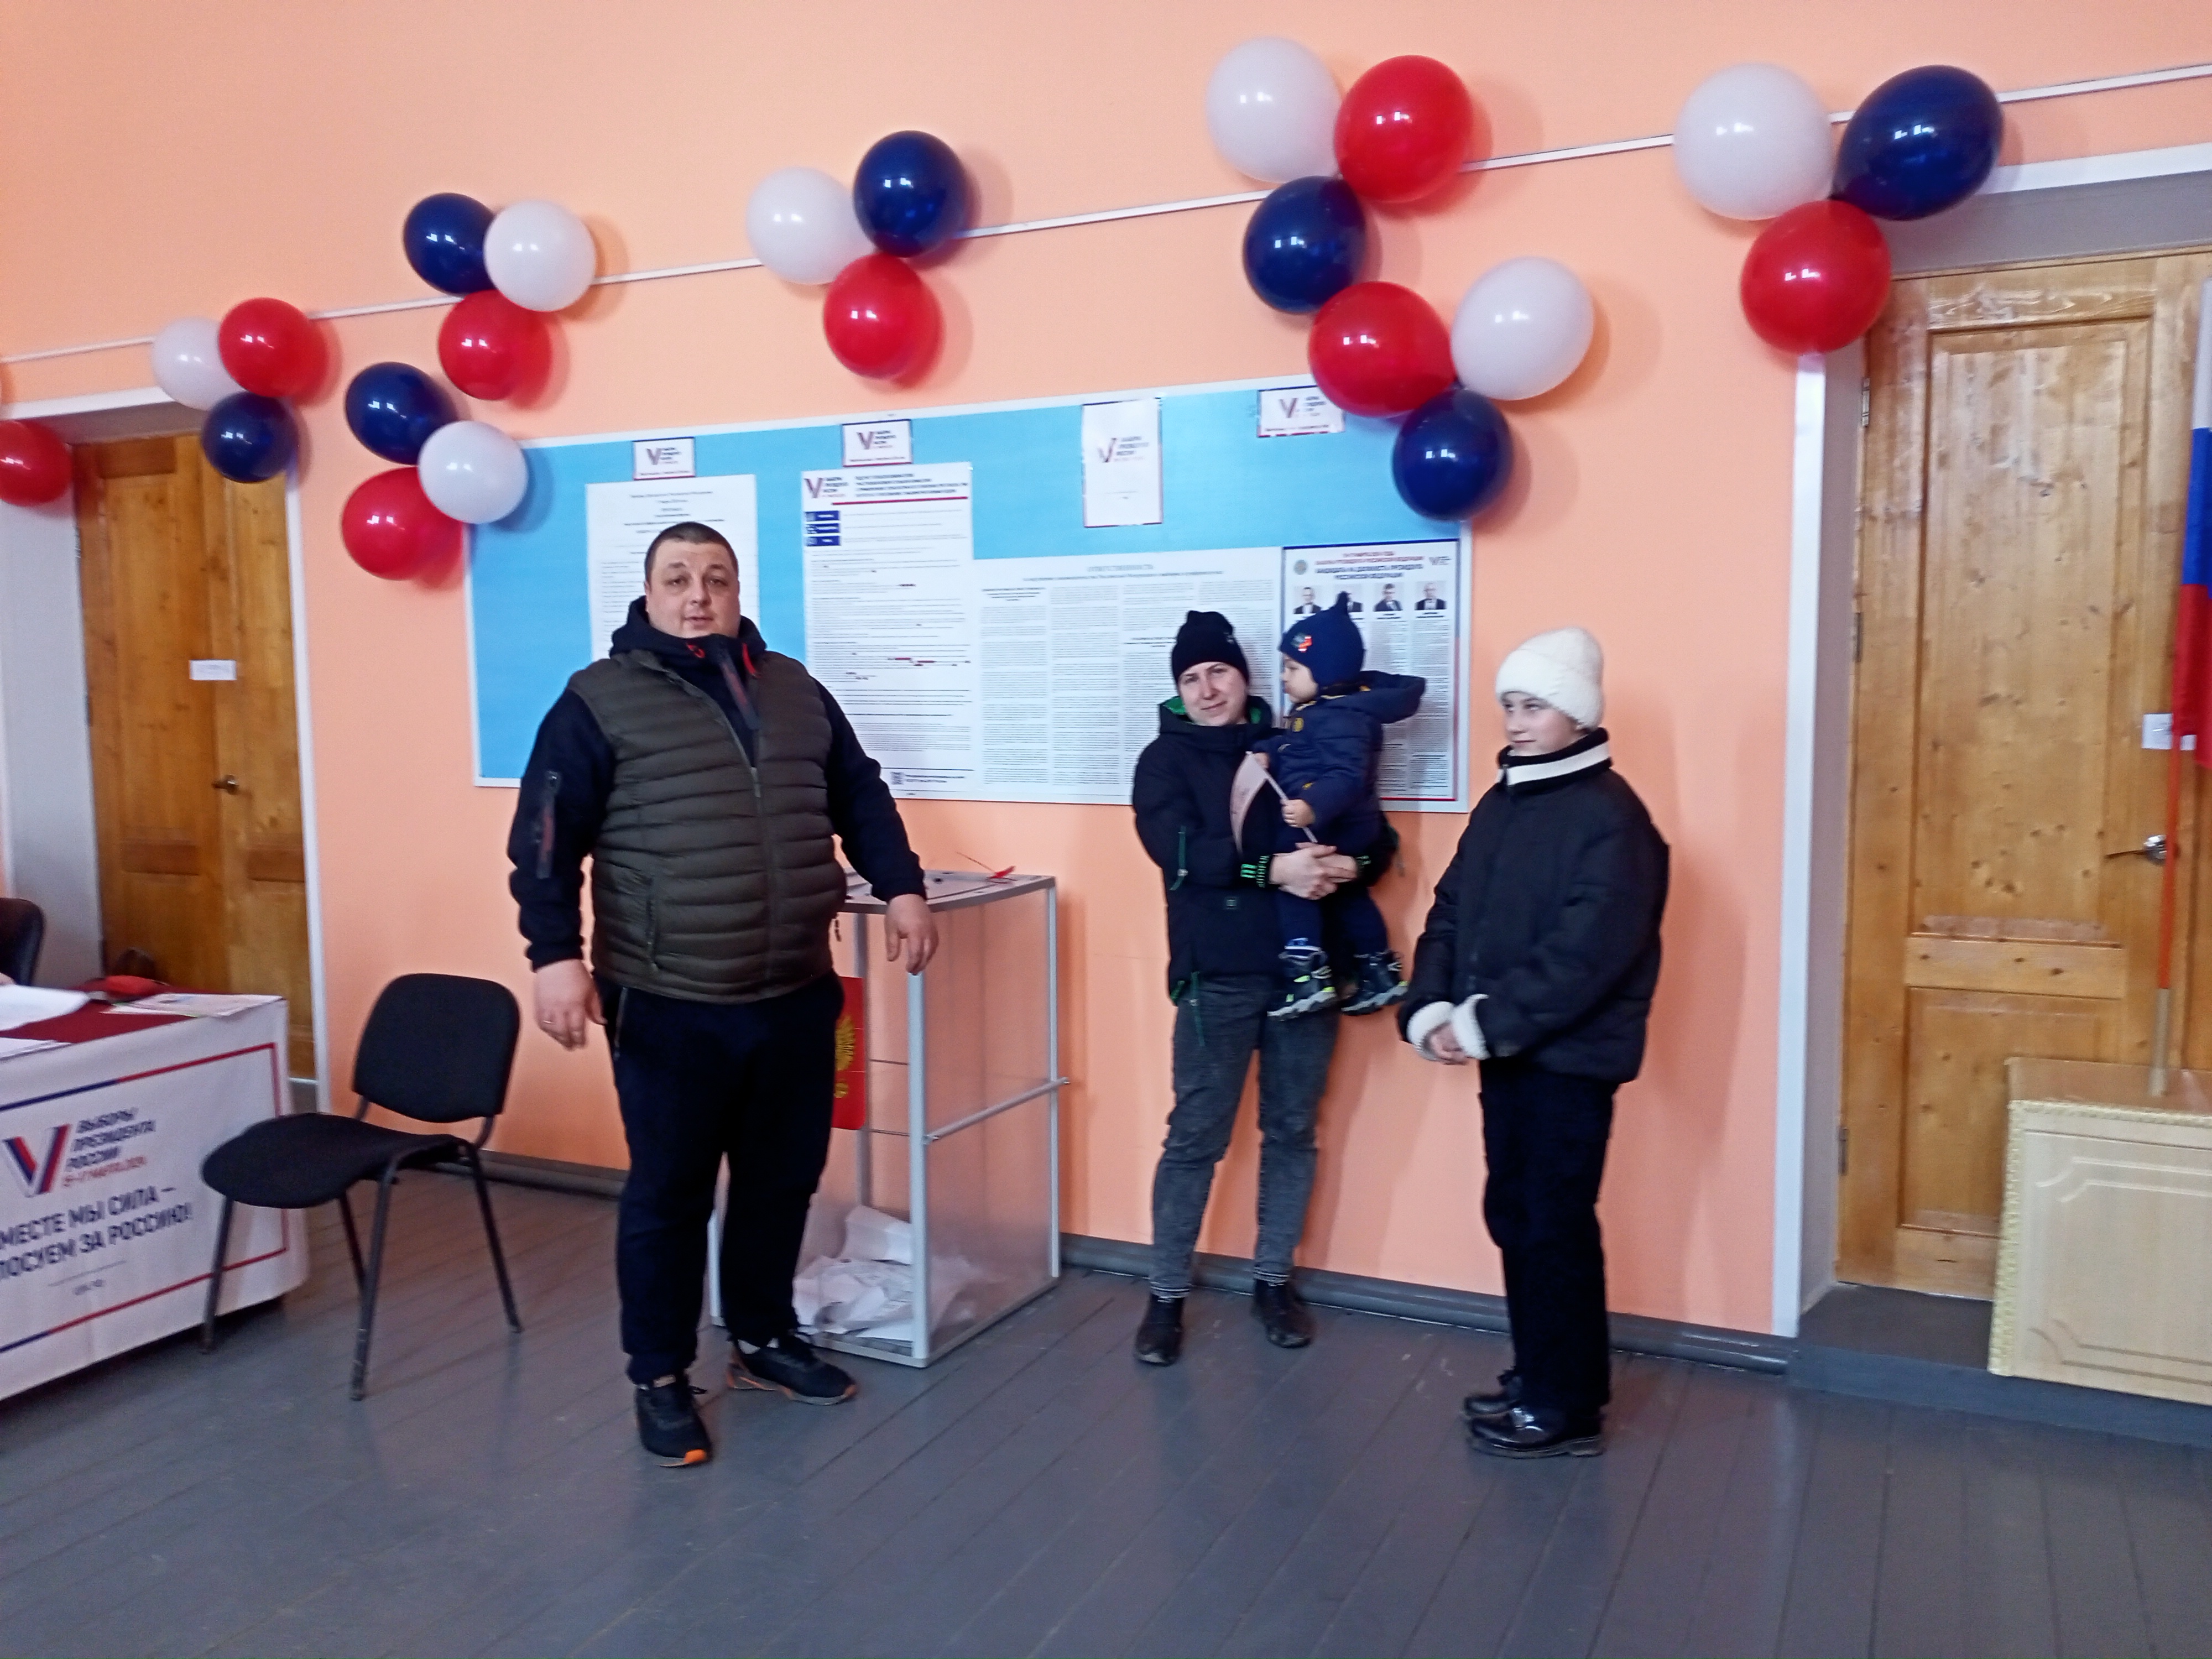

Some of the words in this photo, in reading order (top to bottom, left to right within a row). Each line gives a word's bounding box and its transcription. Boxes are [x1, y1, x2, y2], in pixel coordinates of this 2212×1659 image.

[68, 1201, 106, 1228] МЫ
[108, 1186, 159, 1215] СИЛА
[80, 1230, 106, 1253] ЗА
[108, 1202, 191, 1245] РОССИЮ!
